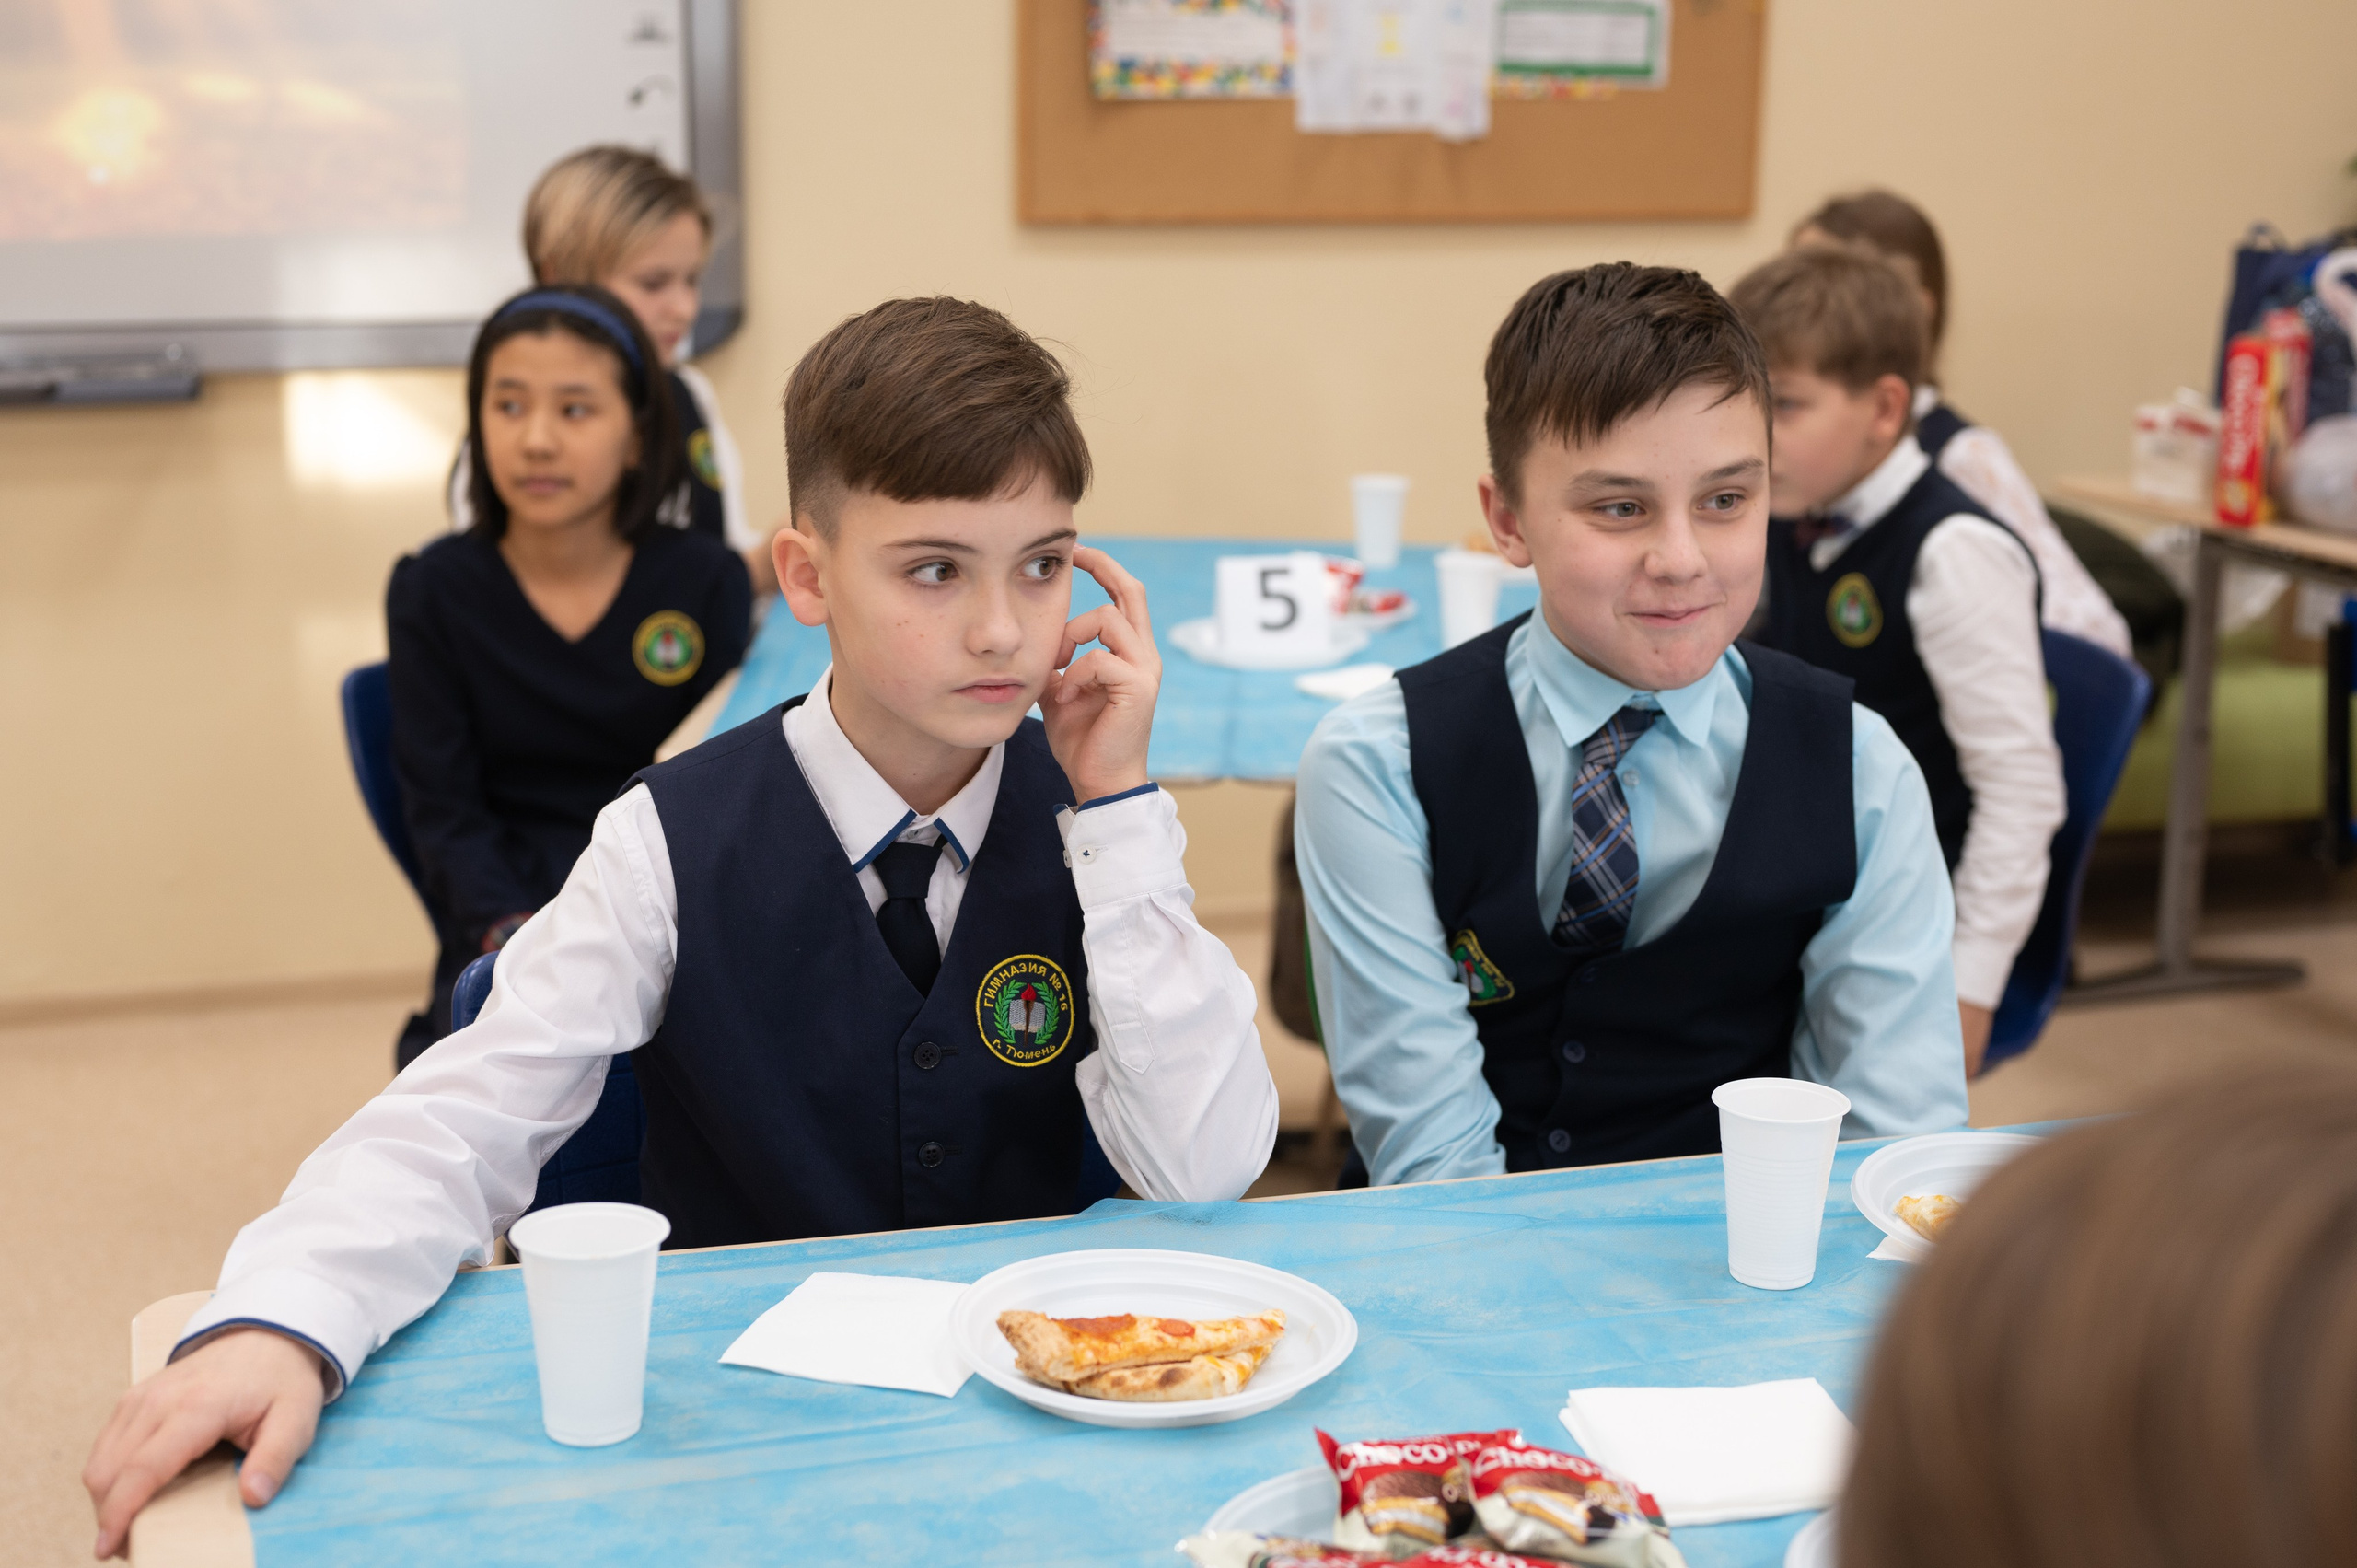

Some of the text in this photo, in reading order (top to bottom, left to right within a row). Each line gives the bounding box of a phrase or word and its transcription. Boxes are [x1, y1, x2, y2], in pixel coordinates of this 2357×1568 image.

[1259, 567, 1299, 631] 5
[984, 962, 1068, 1011] ГИМНАЗИЯ № 16
